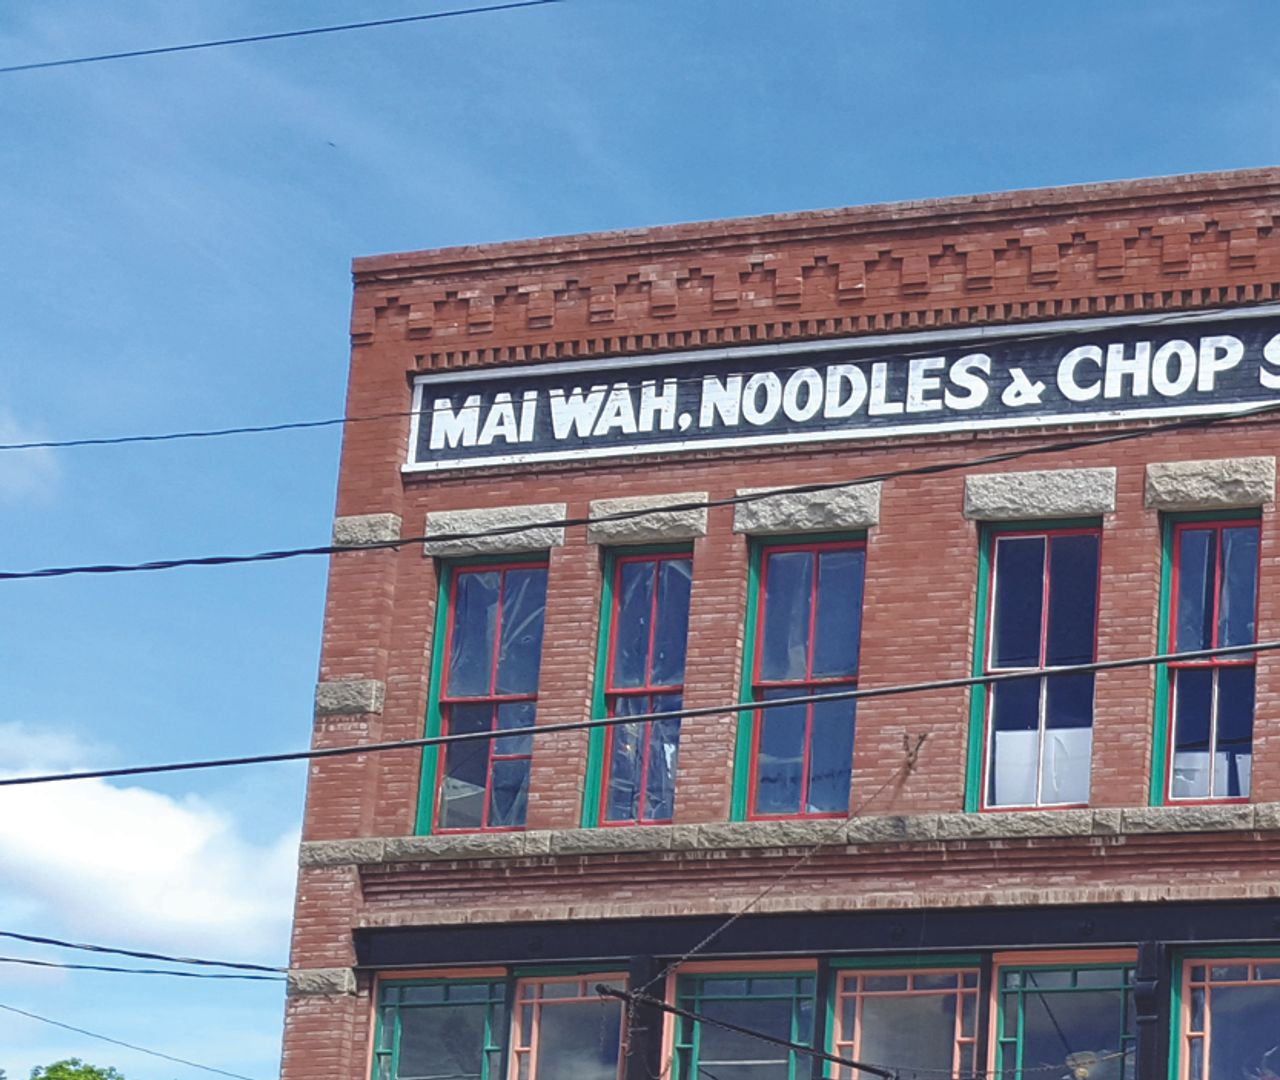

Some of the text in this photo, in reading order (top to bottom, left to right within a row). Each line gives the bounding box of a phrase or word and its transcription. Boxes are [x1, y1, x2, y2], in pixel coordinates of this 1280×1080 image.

[429, 391, 540, 450] MAI
[549, 378, 693, 440] WAH,
[699, 353, 992, 428] NOODLES
[1001, 368, 1046, 407] &
[1056, 335, 1245, 402] CHOP
